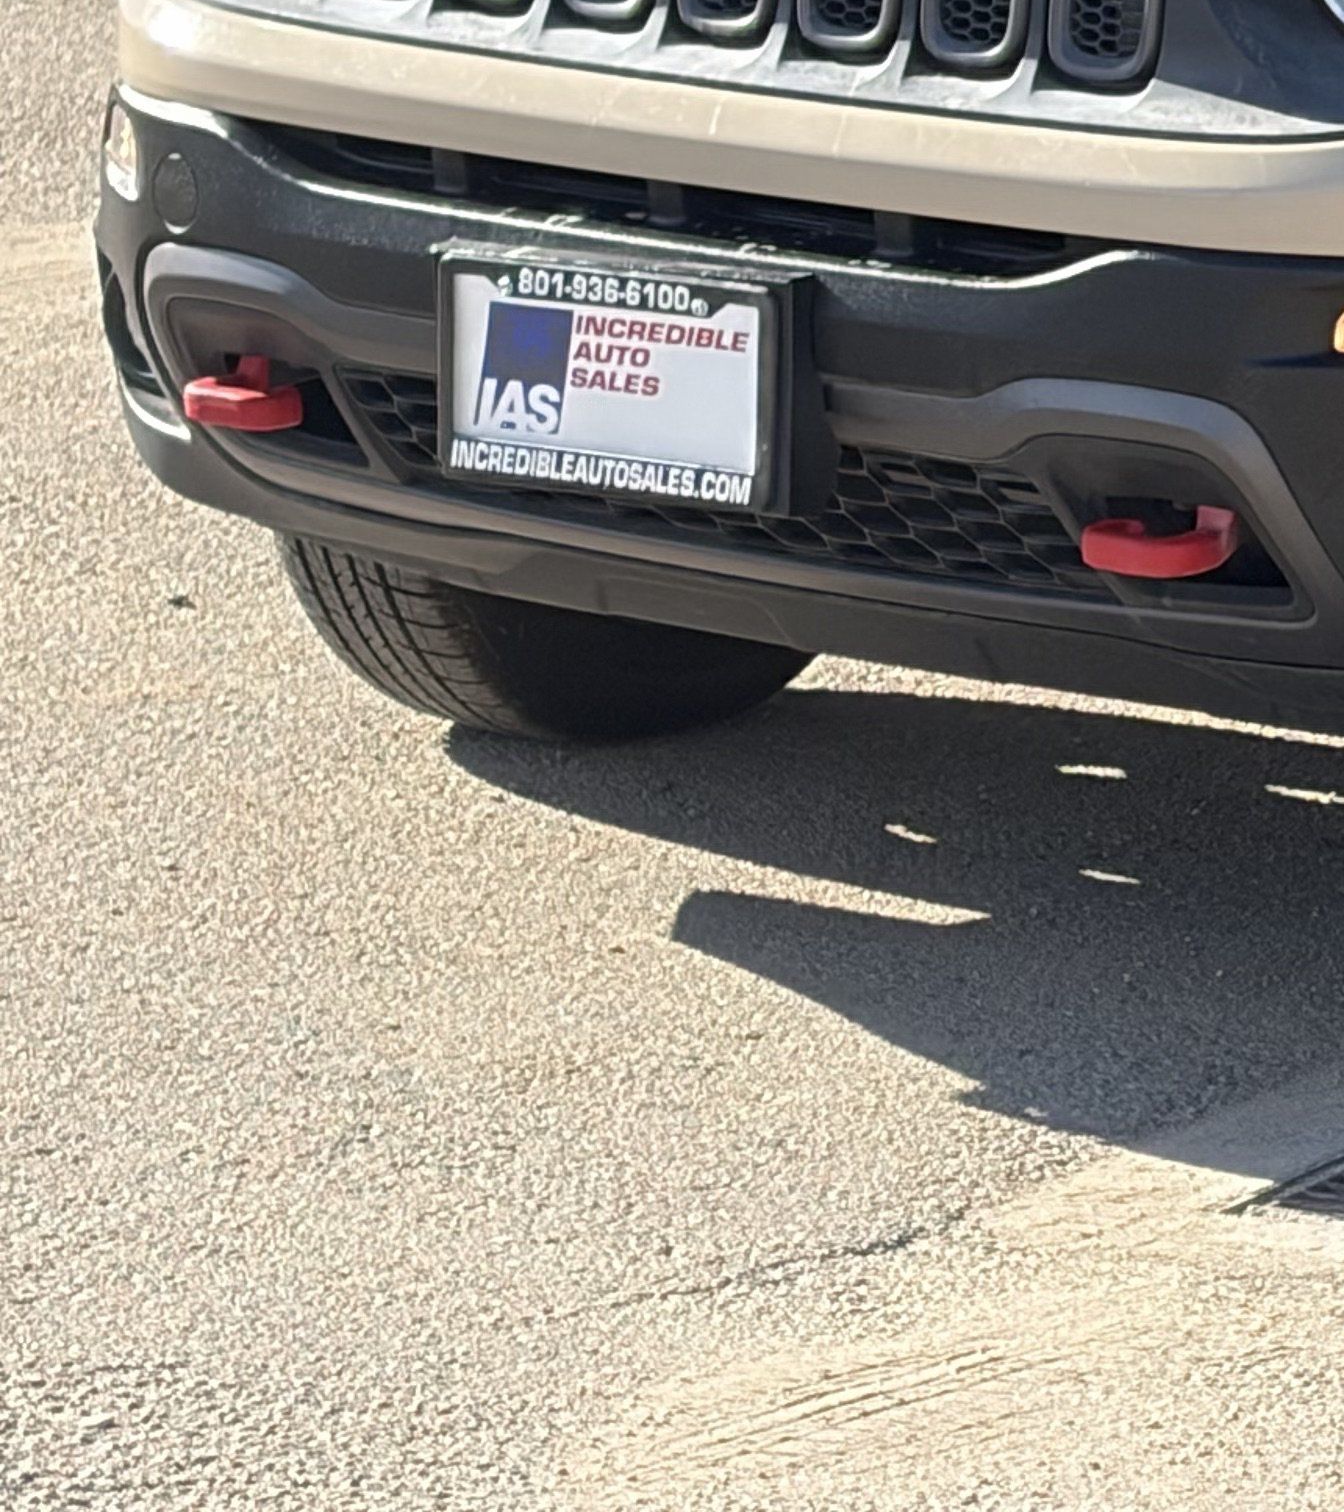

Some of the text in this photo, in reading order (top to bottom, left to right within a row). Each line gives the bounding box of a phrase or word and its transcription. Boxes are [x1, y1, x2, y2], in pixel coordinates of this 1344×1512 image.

[518, 267, 690, 312] 801-936-6100
[575, 315, 750, 353] INCREDIBLE
[573, 342, 651, 368] AUTO
[570, 368, 660, 397] SALES
[477, 377, 560, 433] IAS
[450, 439, 752, 506] INCREDIBLEAUTOSALES.COM
